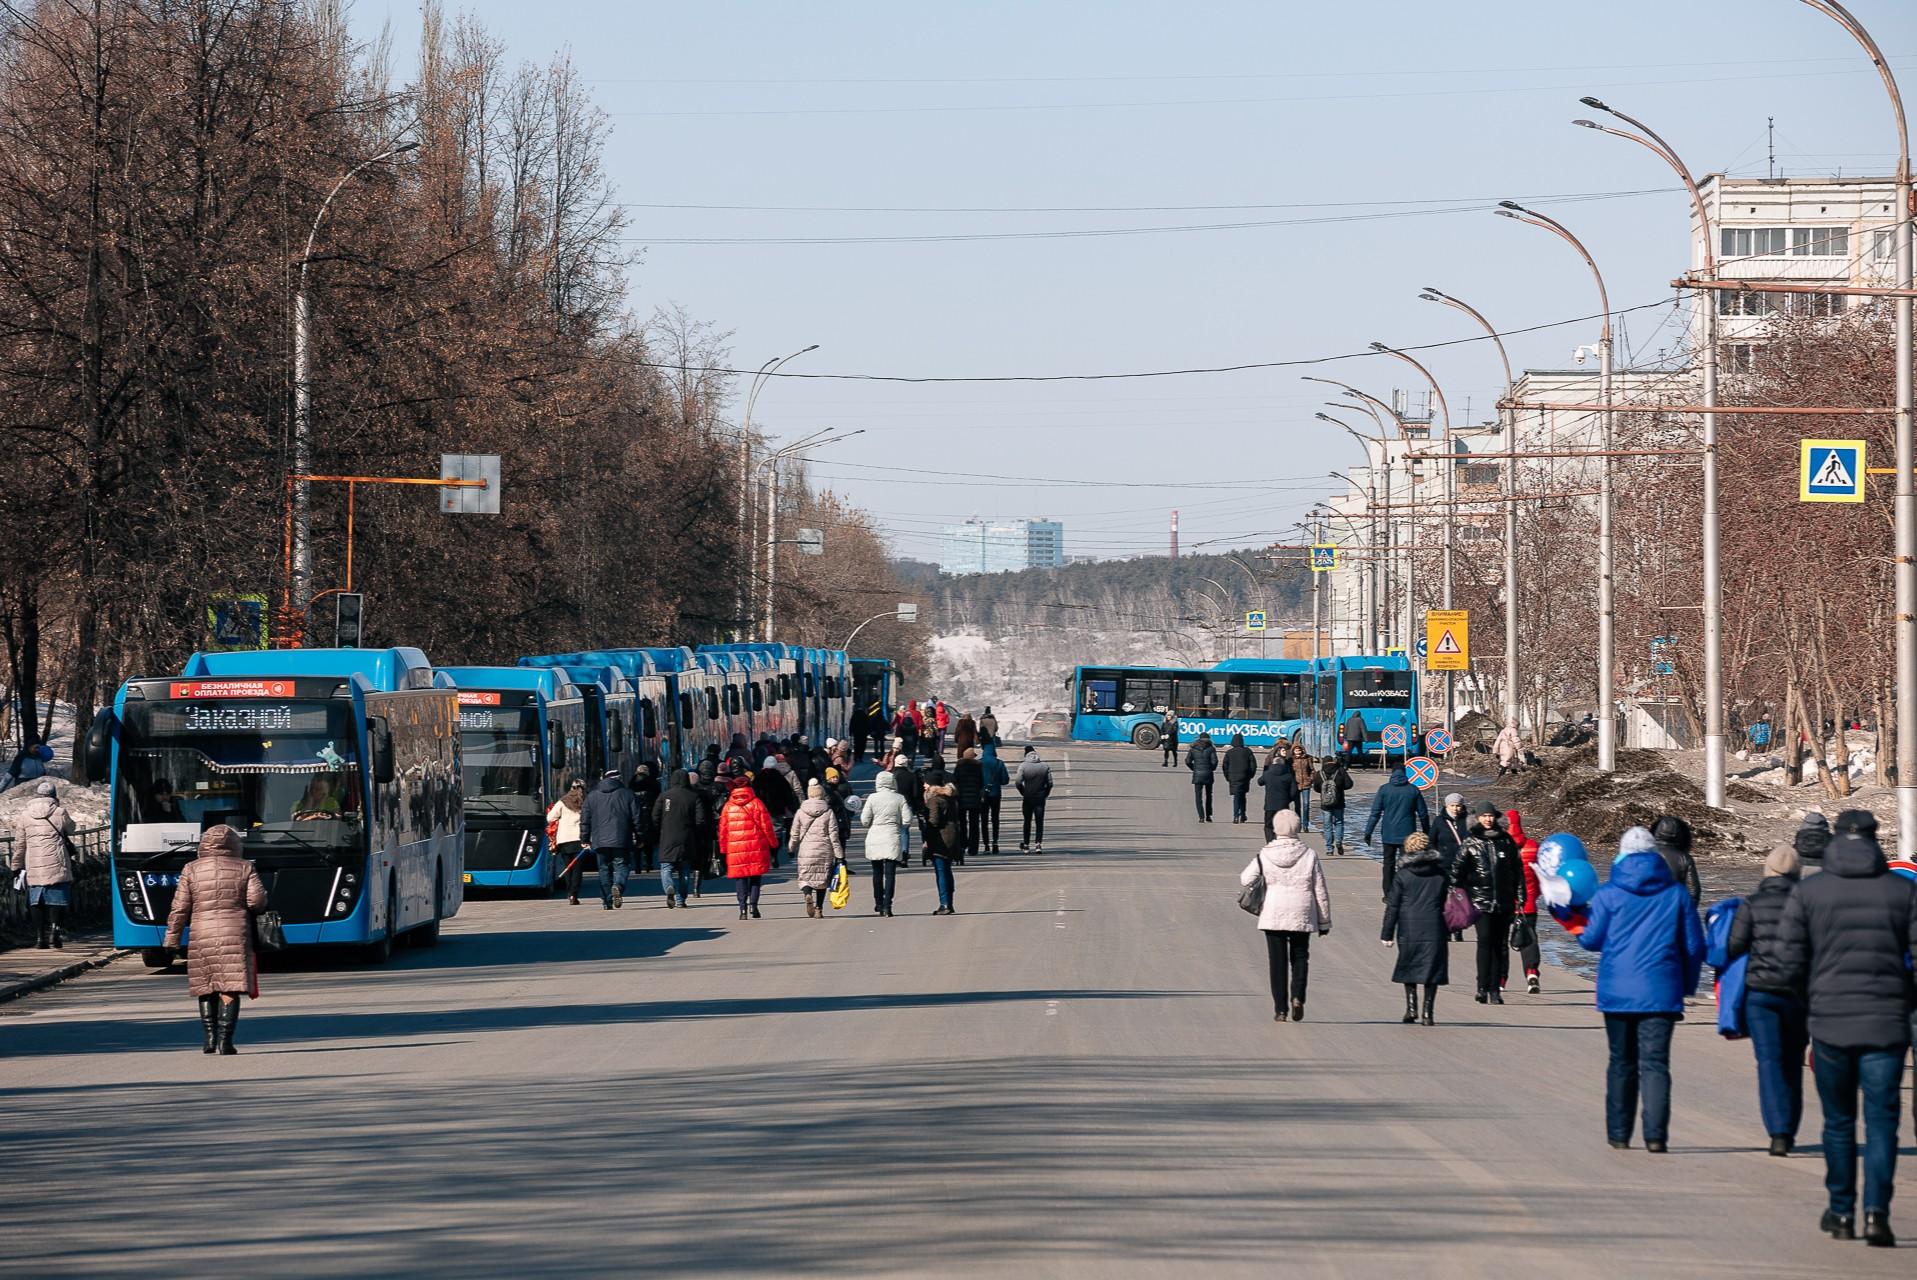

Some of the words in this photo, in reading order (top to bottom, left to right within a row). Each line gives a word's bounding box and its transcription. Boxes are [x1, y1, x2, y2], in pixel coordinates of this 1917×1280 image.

[201, 682, 264, 690] БЕЗНАЛИЧНАЯ
[194, 689, 229, 697] ОПЛАТА
[230, 688, 270, 697] ПРОЕЗДА
[185, 704, 291, 730] Заказной
